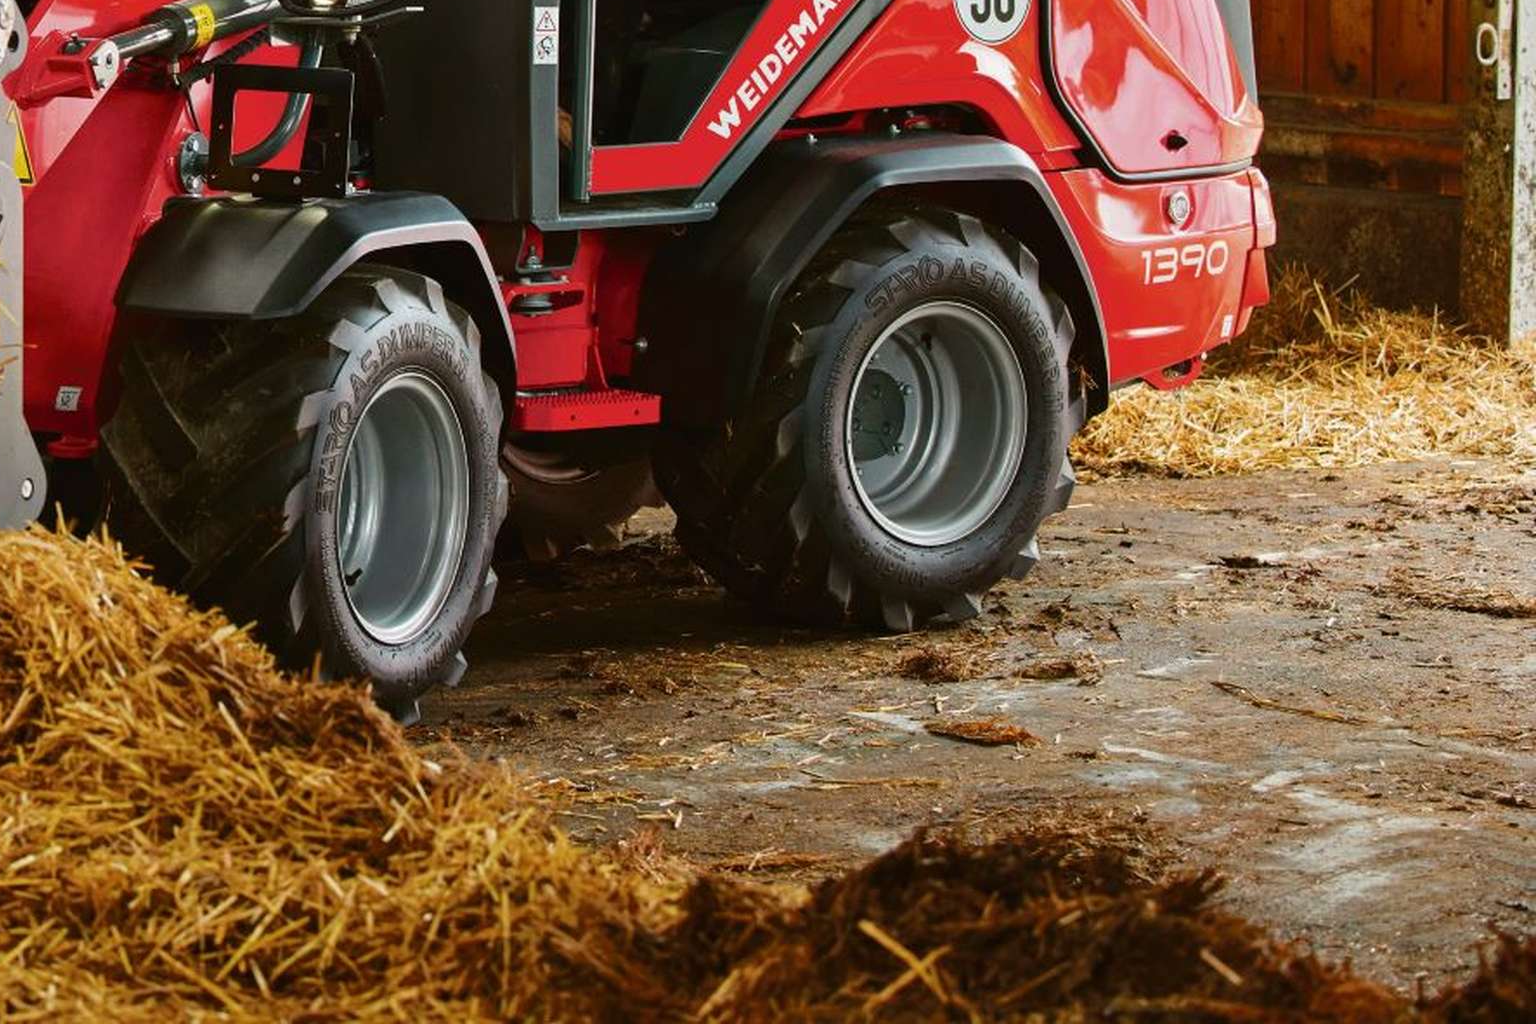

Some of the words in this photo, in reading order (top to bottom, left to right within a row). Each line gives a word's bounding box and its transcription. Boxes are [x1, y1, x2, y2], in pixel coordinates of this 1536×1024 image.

[1141, 240, 1228, 285] 1390
[951, 257, 987, 290] AS
[989, 271, 1061, 383] DUMPER
